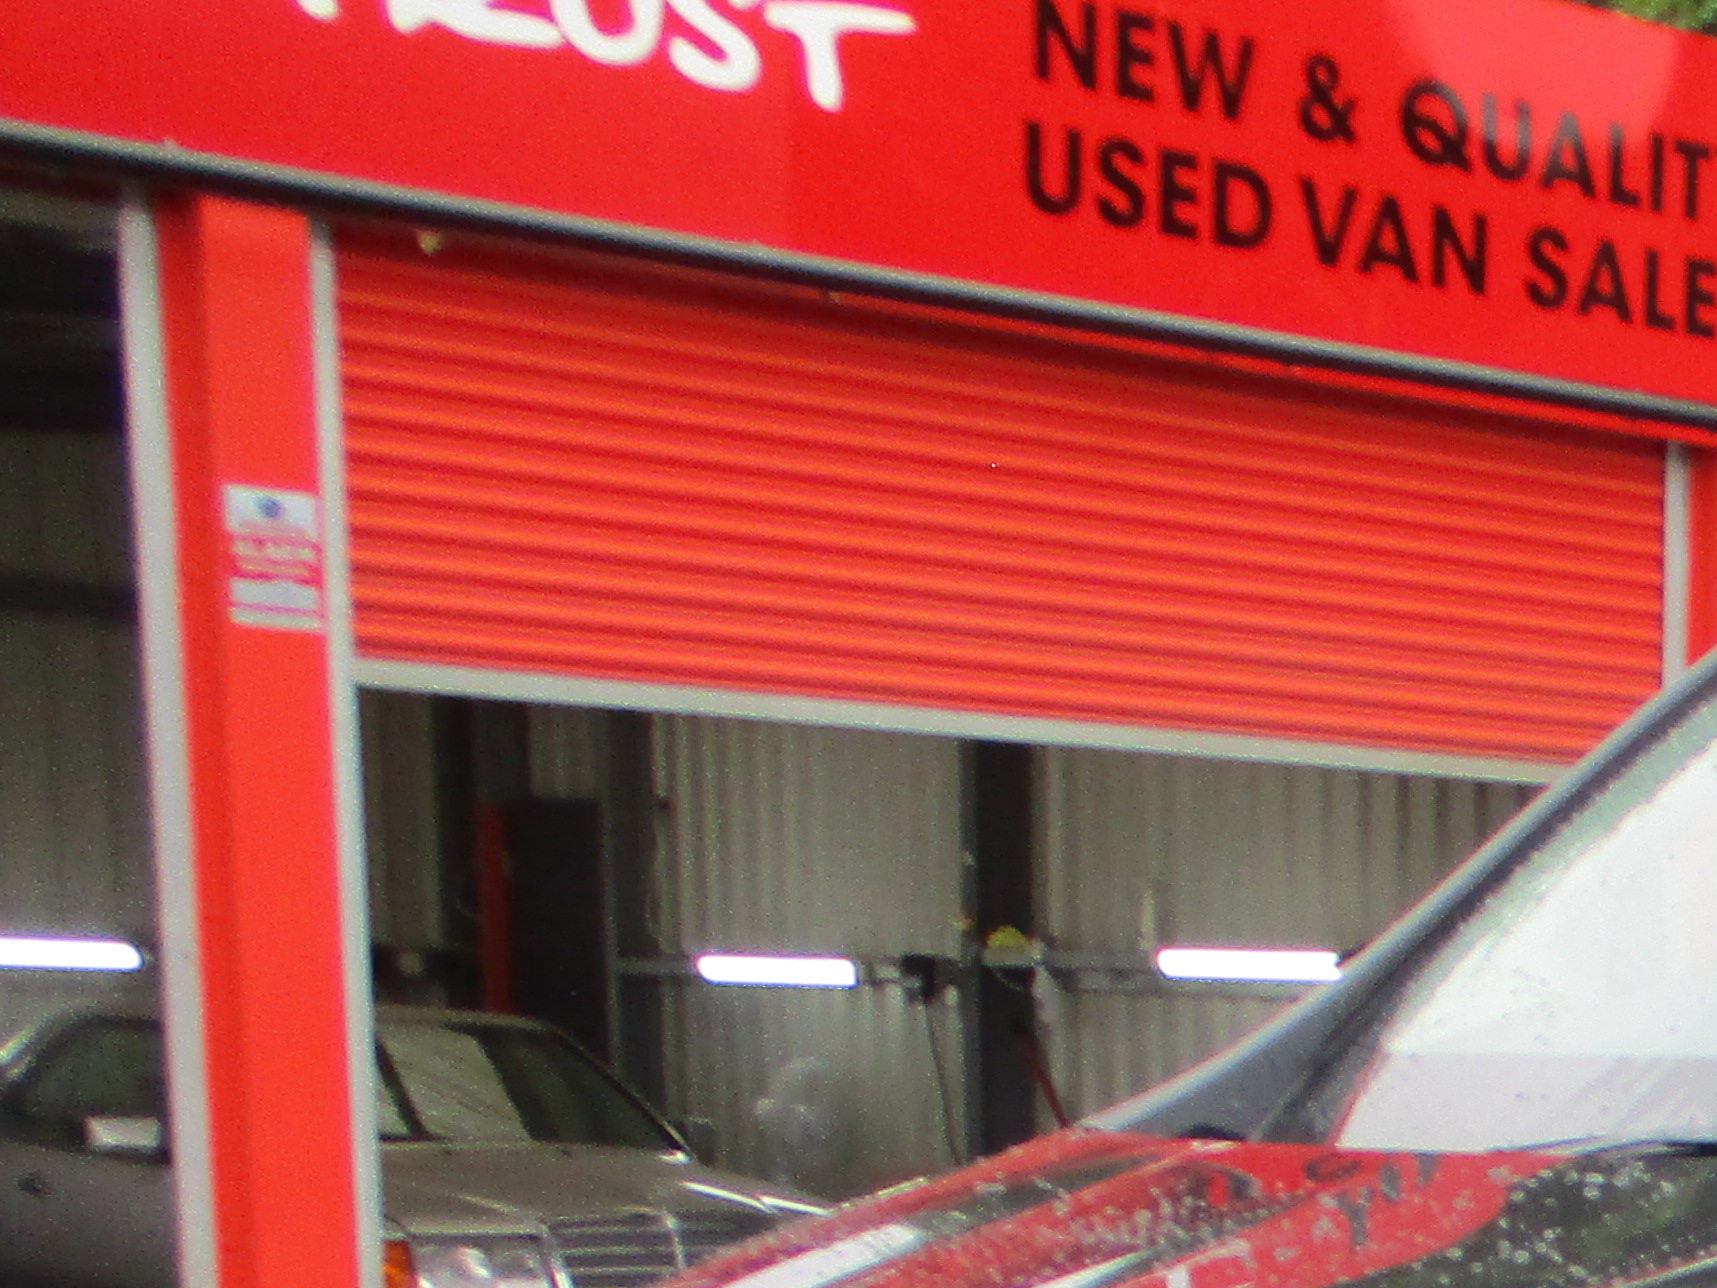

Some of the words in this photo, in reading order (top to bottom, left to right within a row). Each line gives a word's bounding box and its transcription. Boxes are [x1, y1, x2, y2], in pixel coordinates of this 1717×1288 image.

[1034, 0, 1255, 121] NEW
[1299, 54, 1358, 144] &
[1023, 121, 1272, 250] USED
[1300, 176, 1488, 296] VAN
